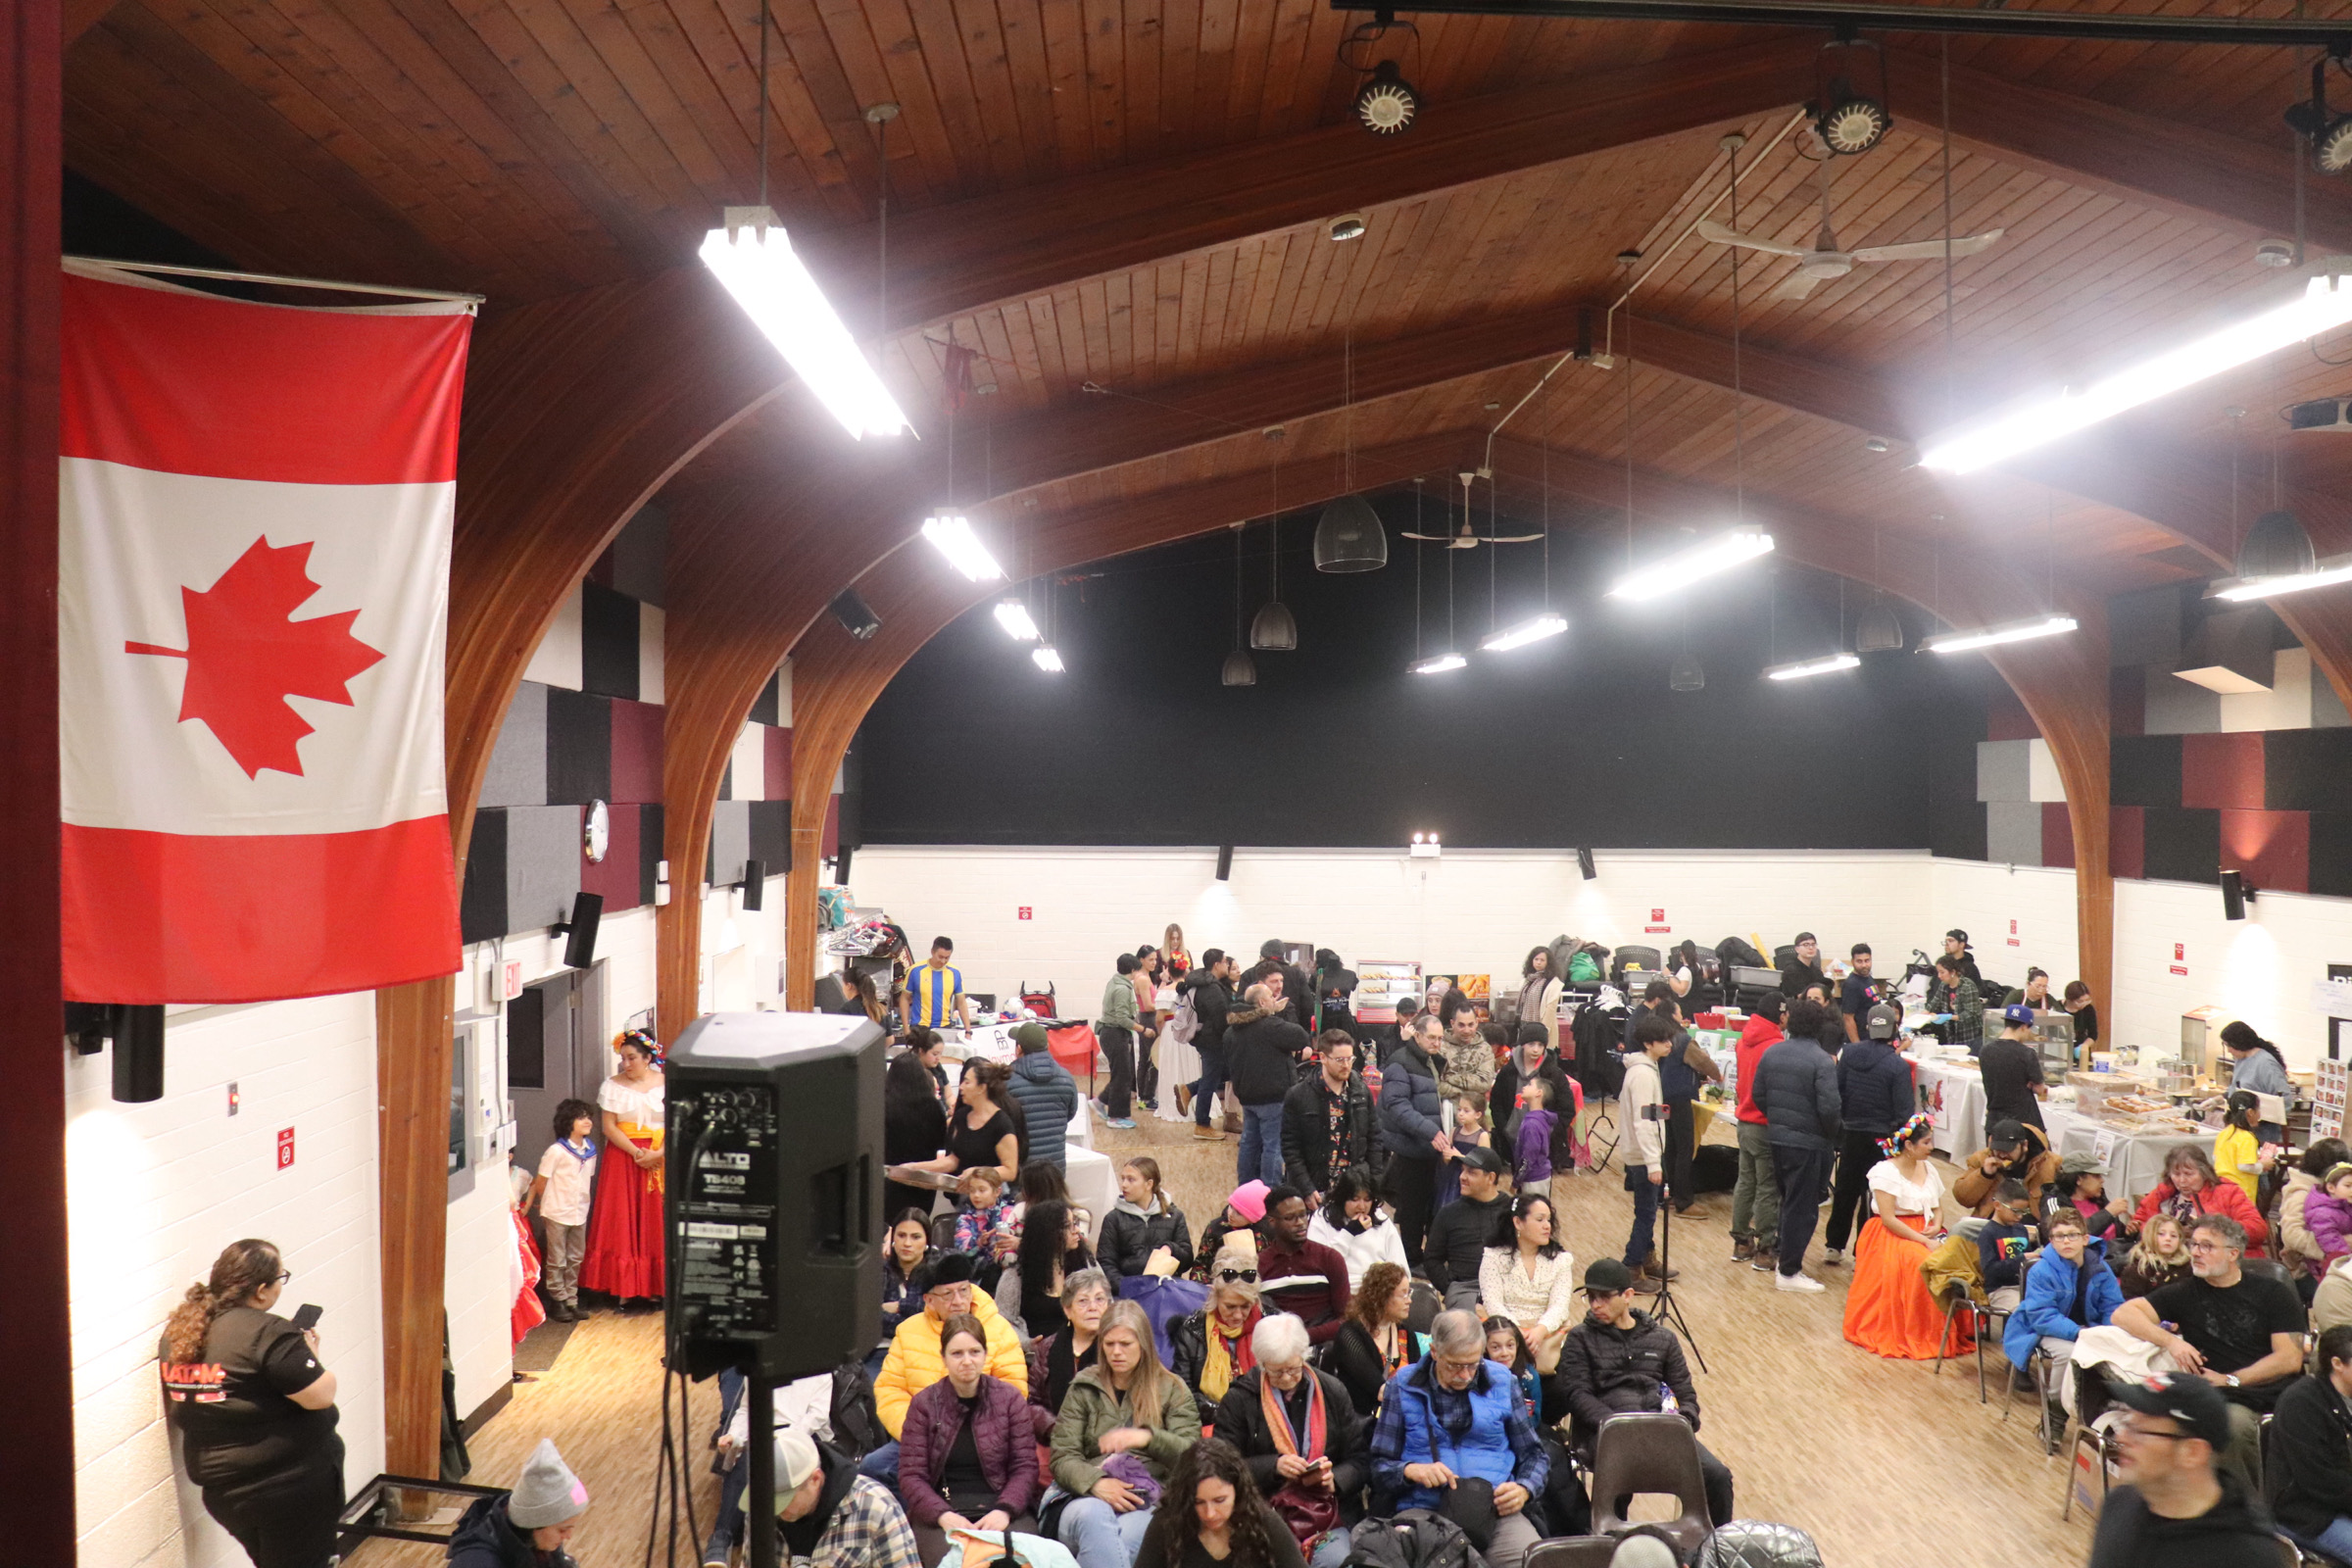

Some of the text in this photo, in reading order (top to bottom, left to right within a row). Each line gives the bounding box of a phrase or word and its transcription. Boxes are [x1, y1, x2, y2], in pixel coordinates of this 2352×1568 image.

[506, 961, 520, 997] EXIT
[699, 1150, 751, 1165] ALTO
[161, 1361, 222, 1385] LATAM
